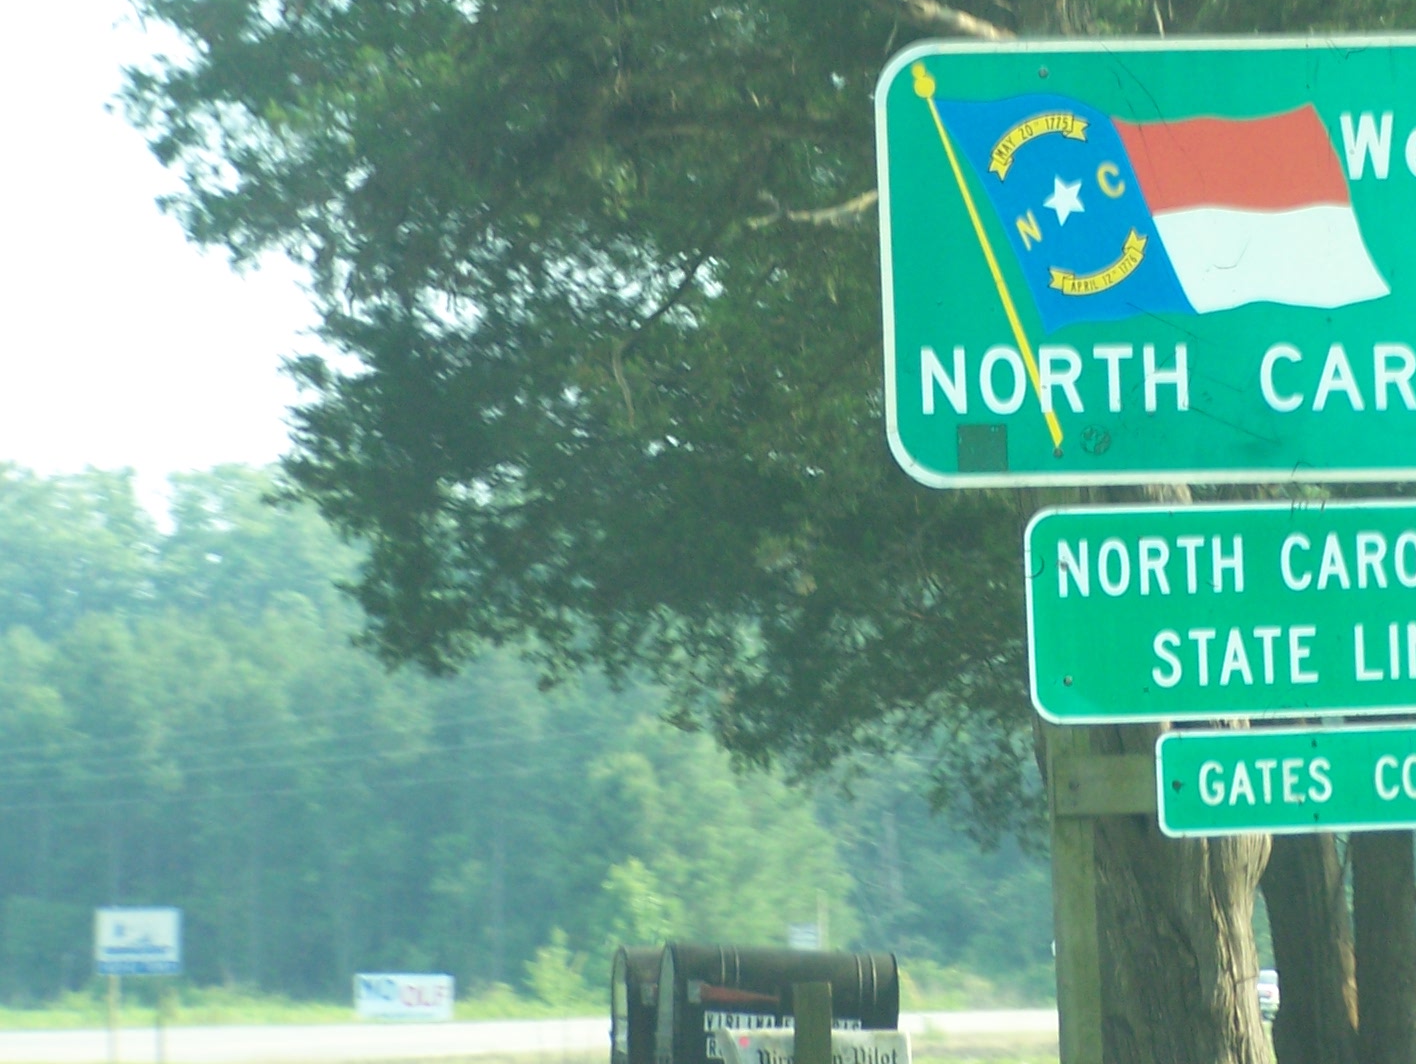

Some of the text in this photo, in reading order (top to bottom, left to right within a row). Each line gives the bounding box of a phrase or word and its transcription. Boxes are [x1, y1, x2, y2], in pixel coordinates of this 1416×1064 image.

[994, 135, 1016, 161] MAY
[1044, 116, 1069, 130] 1775
[1016, 161, 1125, 251] N C
[1070, 279, 1099, 293] APRIL
[1117, 253, 1138, 274] 1776
[920, 344, 1189, 416] NORTH
[1057, 535, 1244, 597] NORTH
[1152, 626, 1319, 688] STATE
[1199, 758, 1333, 806] GATES
